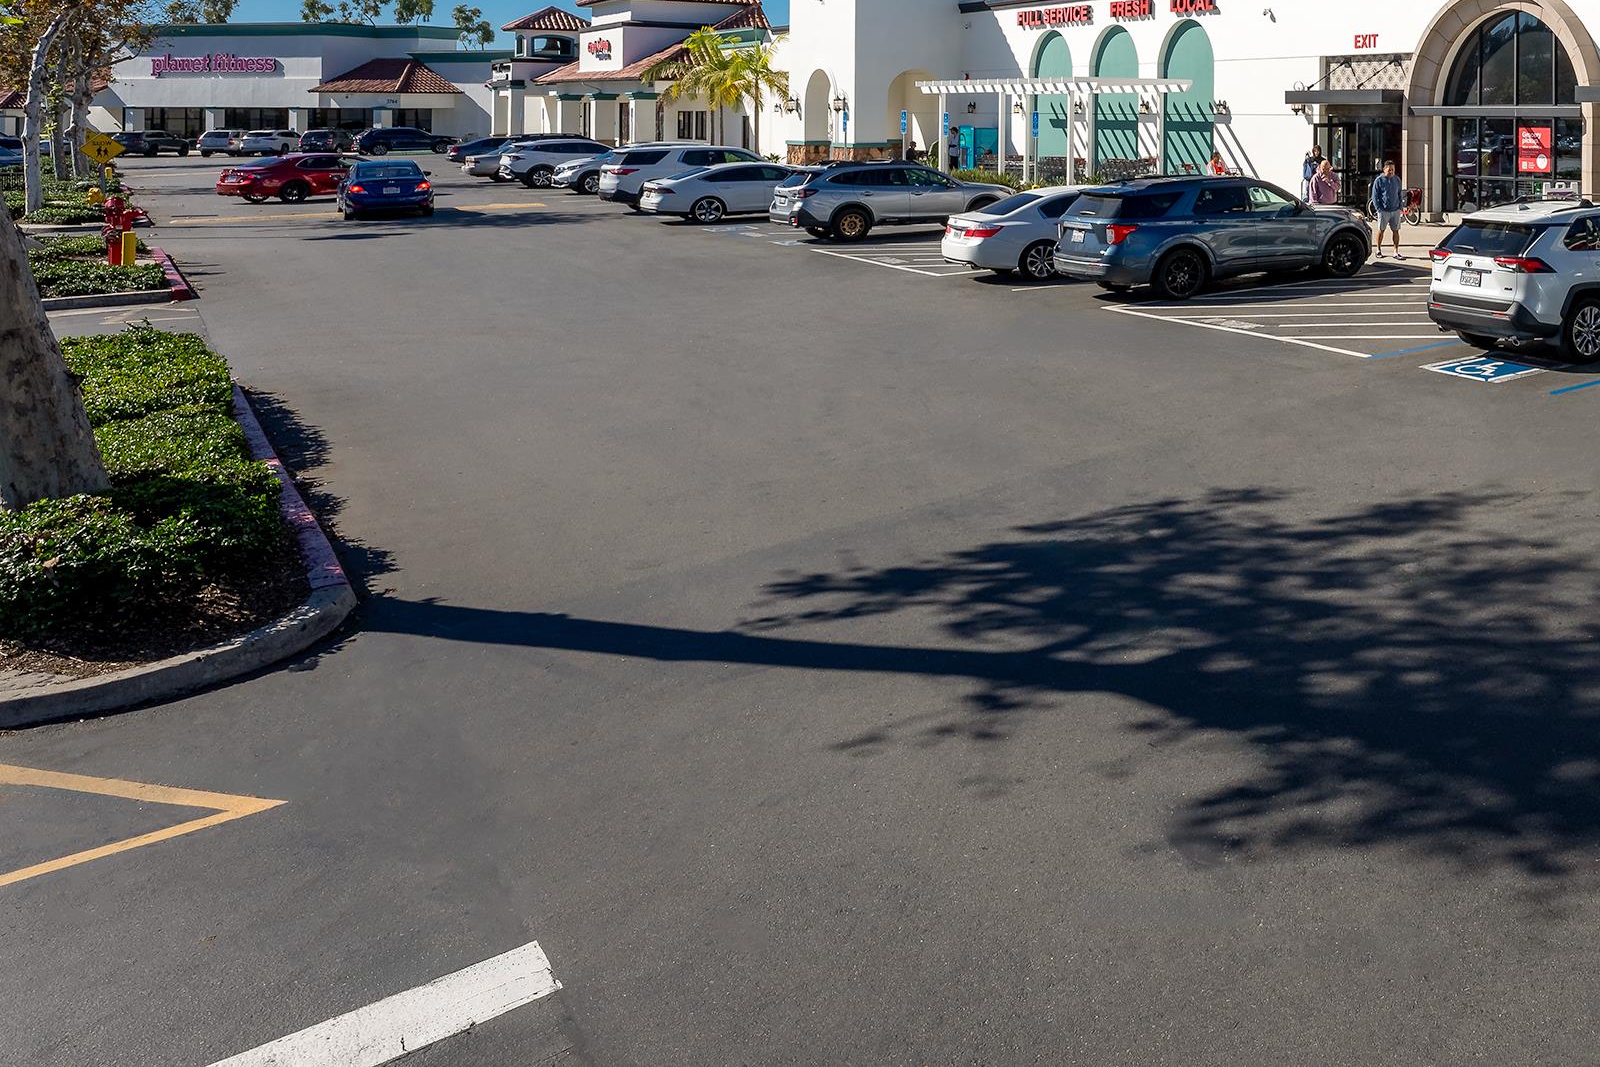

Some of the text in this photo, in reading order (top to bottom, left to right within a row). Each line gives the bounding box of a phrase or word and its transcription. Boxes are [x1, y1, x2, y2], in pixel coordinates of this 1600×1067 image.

[1016, 10, 1041, 27] FULL
[1042, 4, 1089, 25] SERVICE
[1109, 0, 1150, 18] FRESH
[1354, 33, 1379, 49] EXIT
[150, 53, 277, 78] planet fitness
